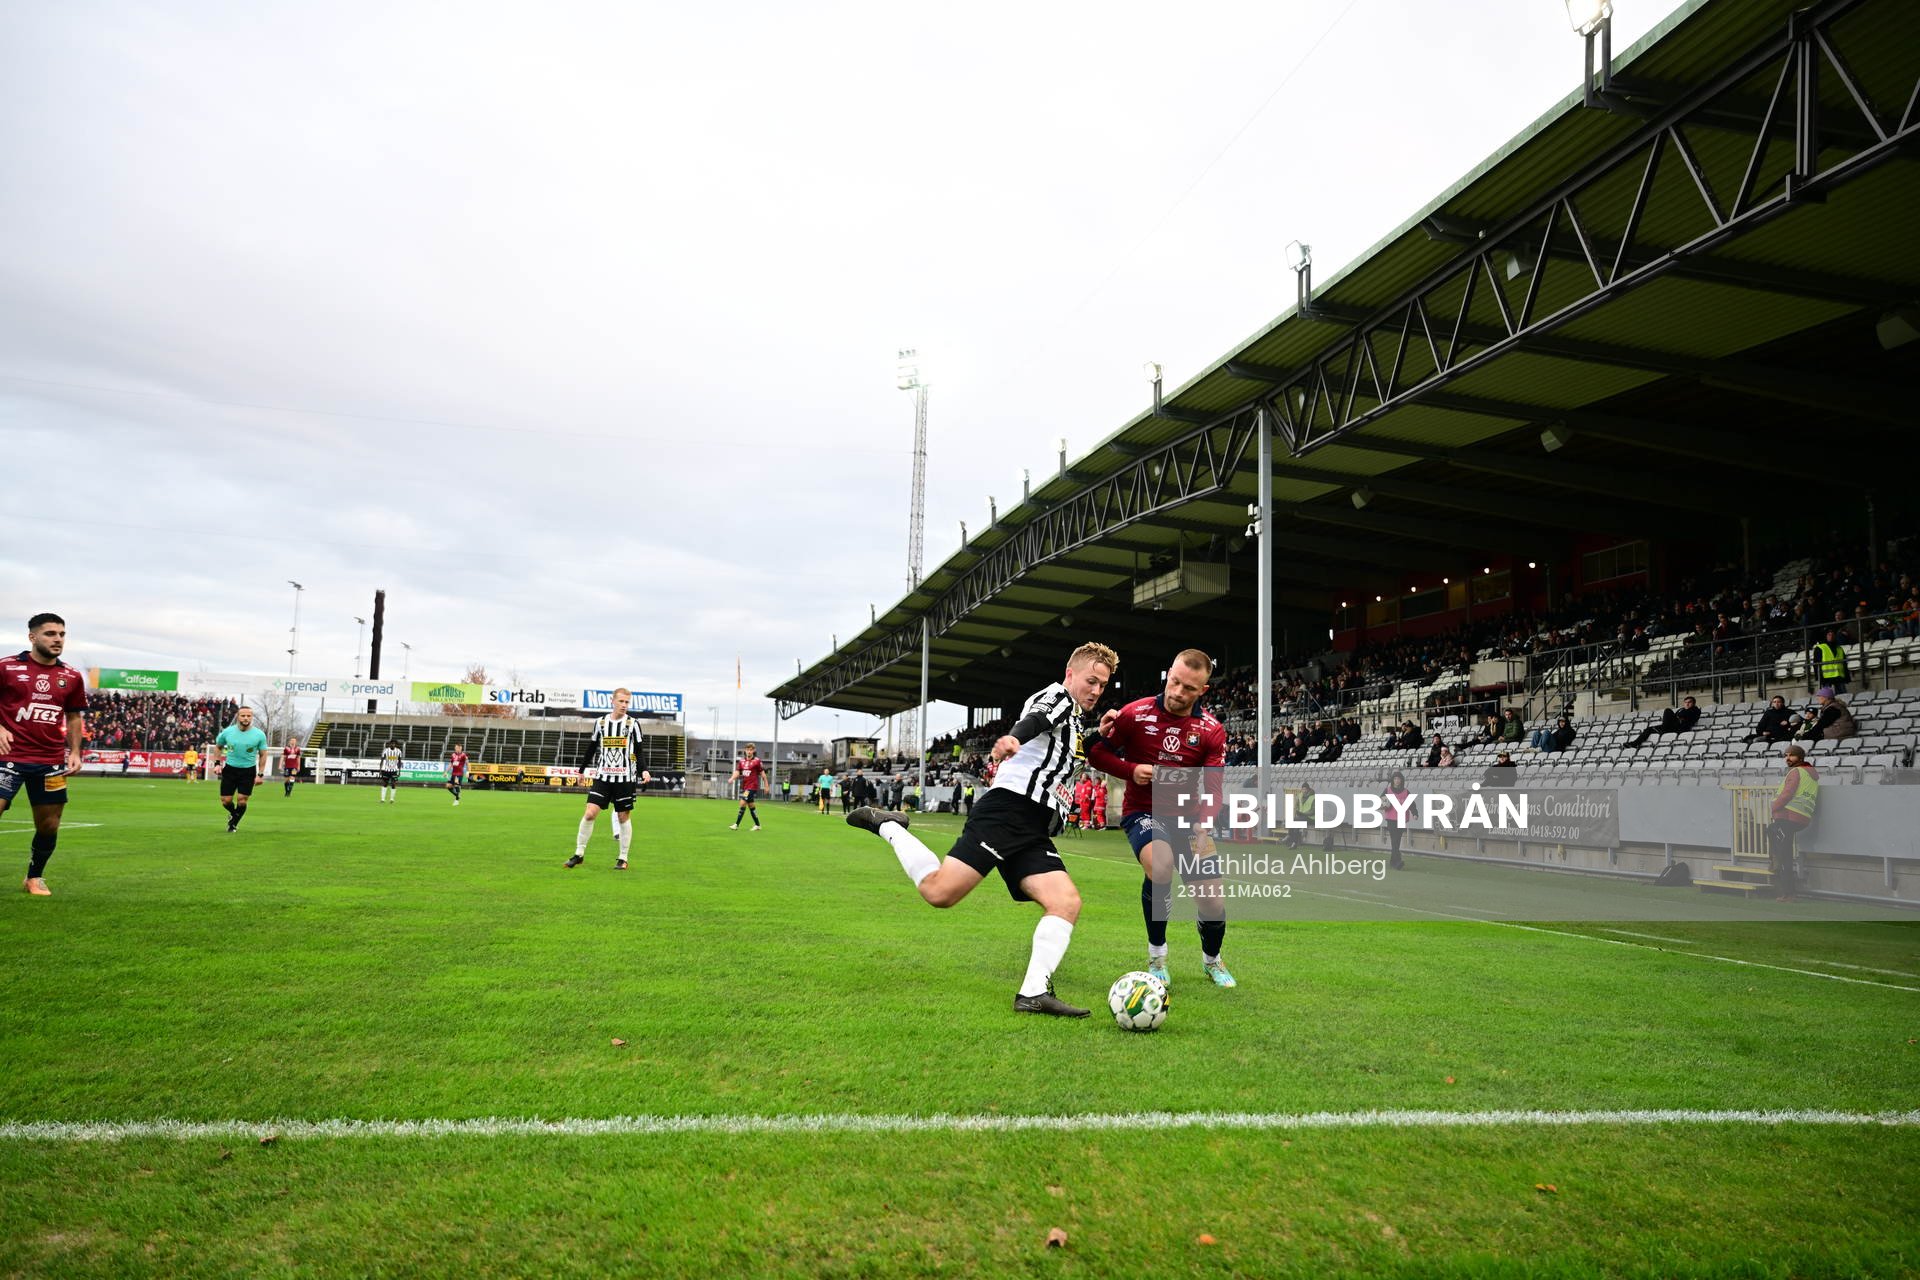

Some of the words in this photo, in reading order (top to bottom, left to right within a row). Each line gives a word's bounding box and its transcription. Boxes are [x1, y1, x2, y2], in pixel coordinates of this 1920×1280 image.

[126, 675, 158, 685] alfdex
[285, 680, 327, 692] prenad
[352, 684, 393, 695] prenad
[489, 689, 545, 704] sortab
[587, 690, 679, 710] NORVIDINGE
[16, 703, 62, 725] NTEX
[400, 761, 439, 771] azars
[521, 776, 545, 784] eklam
[1544, 795, 1611, 819] Conditori
[1531, 825, 1567, 839] 0418-592
[1568, 827, 1580, 840] 00
